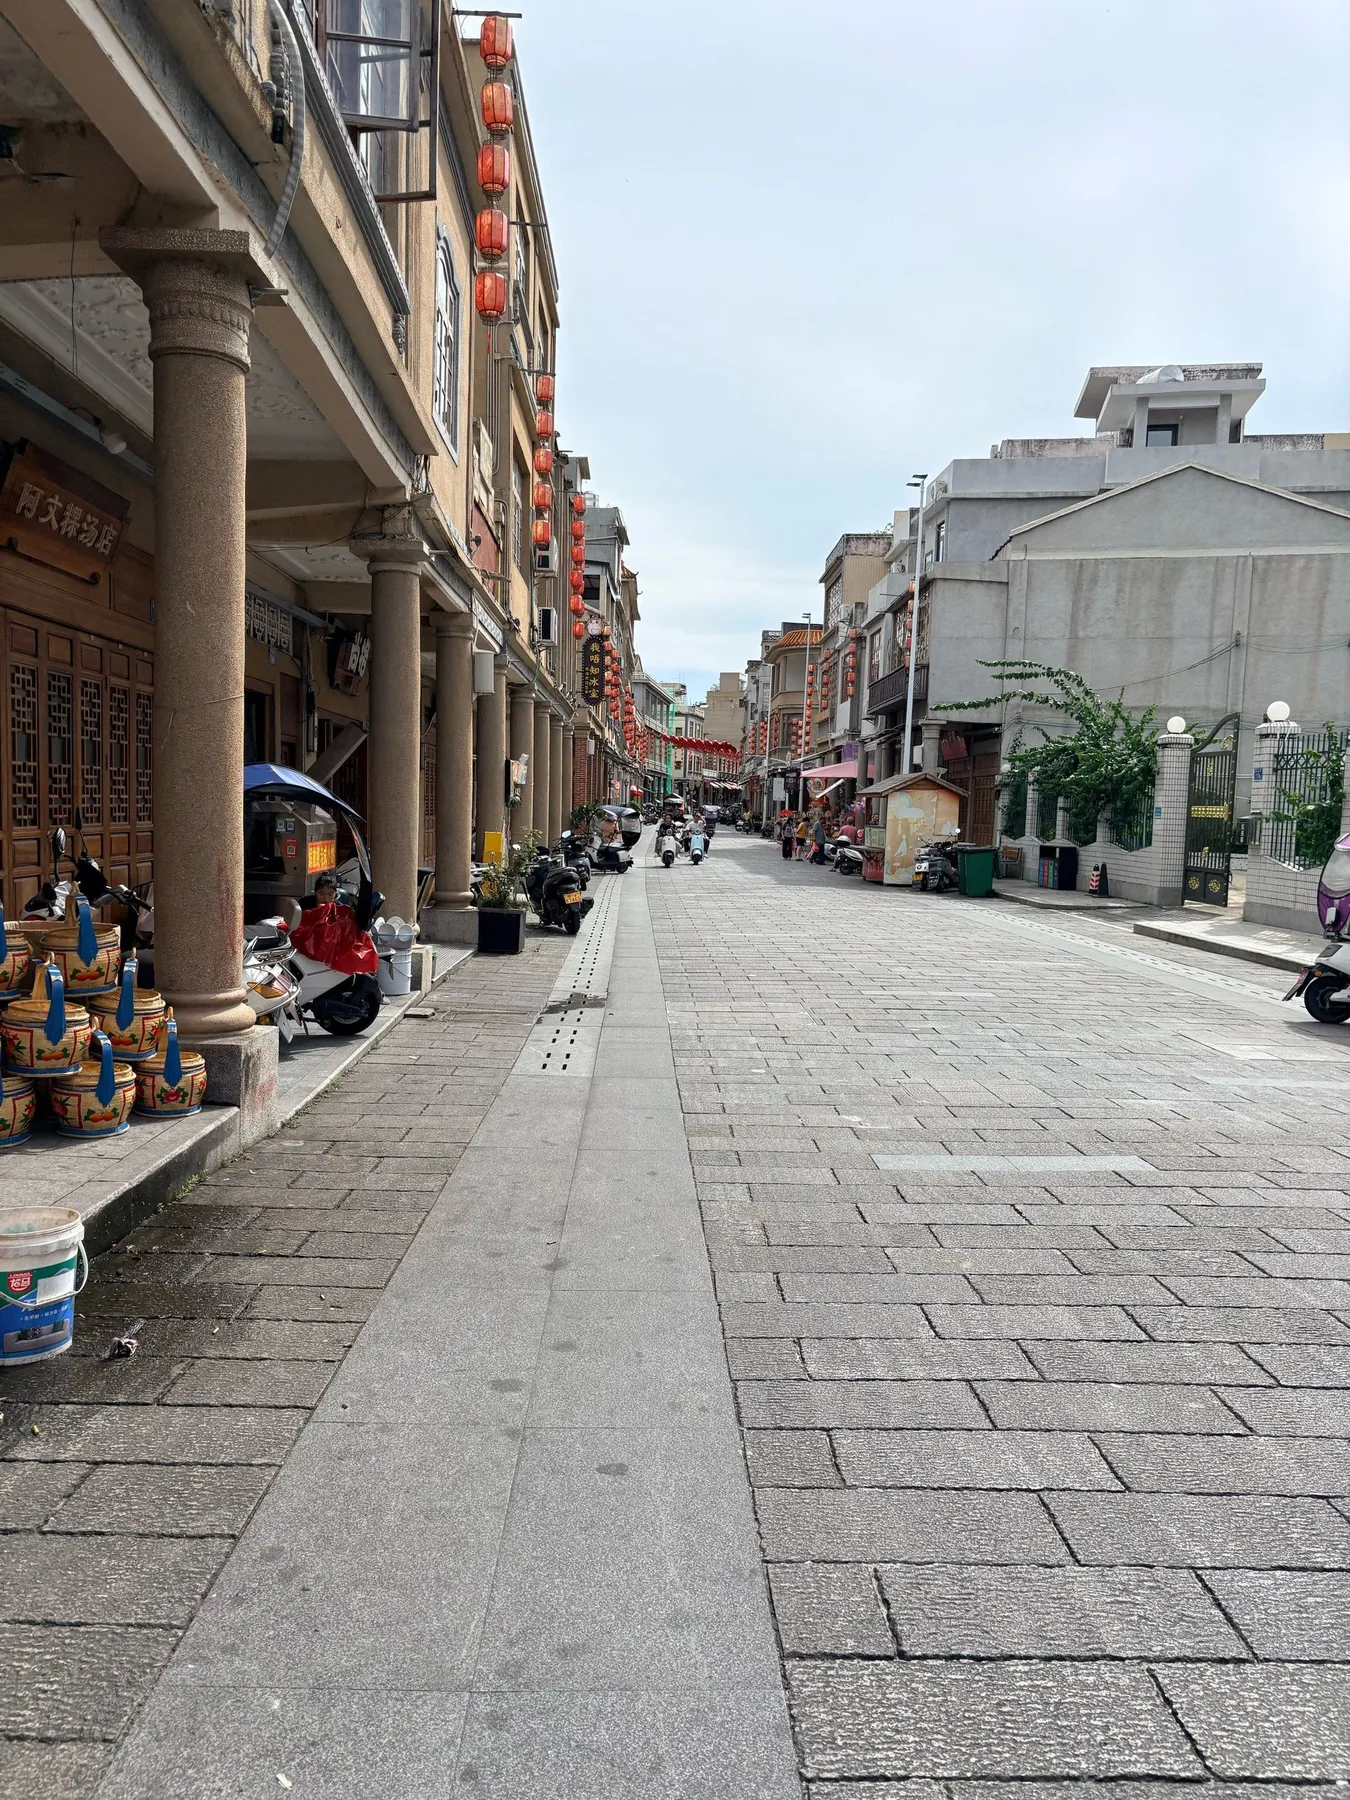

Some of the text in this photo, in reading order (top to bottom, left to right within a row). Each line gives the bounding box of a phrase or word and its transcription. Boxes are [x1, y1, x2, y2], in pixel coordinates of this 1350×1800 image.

[15, 482, 118, 555] 阿文粿汤店
